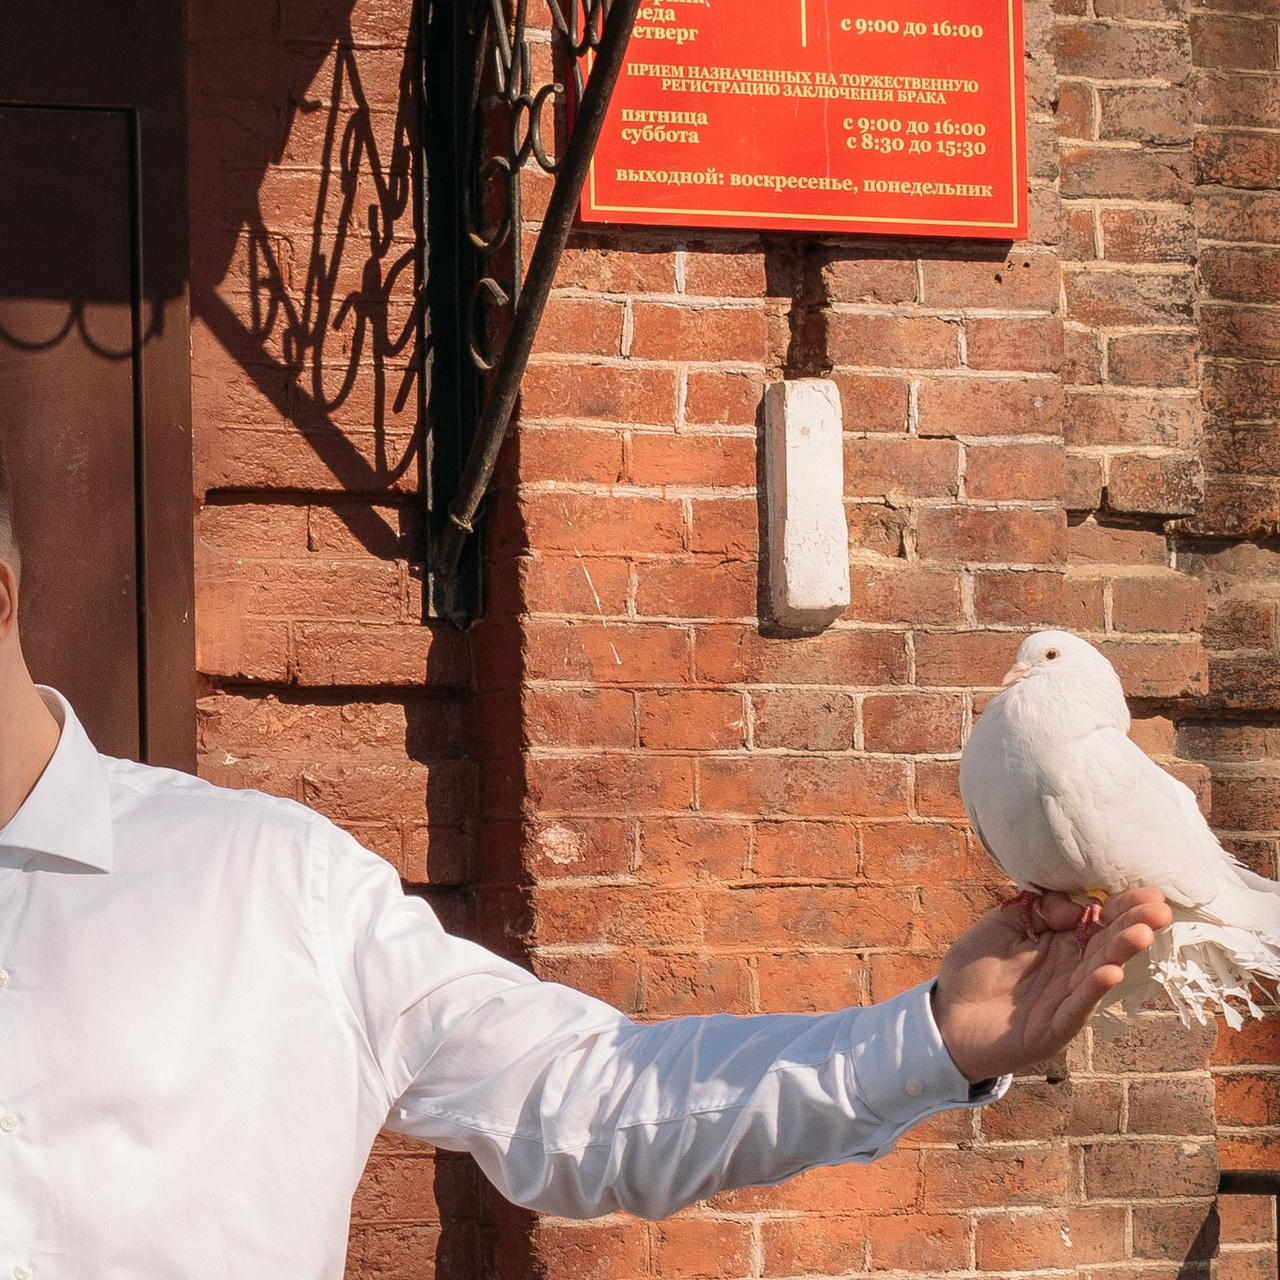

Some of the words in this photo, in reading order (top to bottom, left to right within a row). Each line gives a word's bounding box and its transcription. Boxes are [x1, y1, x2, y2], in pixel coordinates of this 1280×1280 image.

[630, 25, 699, 45] етверг
[841, 17, 851, 31] с
[855, 17, 899, 35] 9:00
[903, 22, 927, 36] до
[931, 20, 984, 38] 16:00
[626, 63, 685, 78] ПРИЕМ
[687, 66, 812, 84] НАЗНАЧЕННЫХ
[814, 72, 837, 86] НА
[839, 73, 979, 93] ТОРЖЕСТВЕННУЮ
[661, 79, 780, 97] РЕГИСТРАЦИЮ
[783, 84, 894, 102] ЗАКЛЮЧЕНИЯ
[898, 90, 947, 104] БРАКА
[621, 108, 708, 127] пятница
[843, 117, 854, 131] с
[857, 117, 901, 134] 9:00
[906, 120, 929, 136] до
[934, 118, 986, 137] 16:00
[621, 125, 700, 144] суббота
[846, 136, 857, 149] с
[861, 133, 904, 154] 8:30
[909, 139, 932, 155] до
[936, 140, 986, 158] 15:30
[616, 167, 725, 187] выходной:
[730, 173, 859, 194] воскресенье,
[863, 179, 993, 197] понедельник
